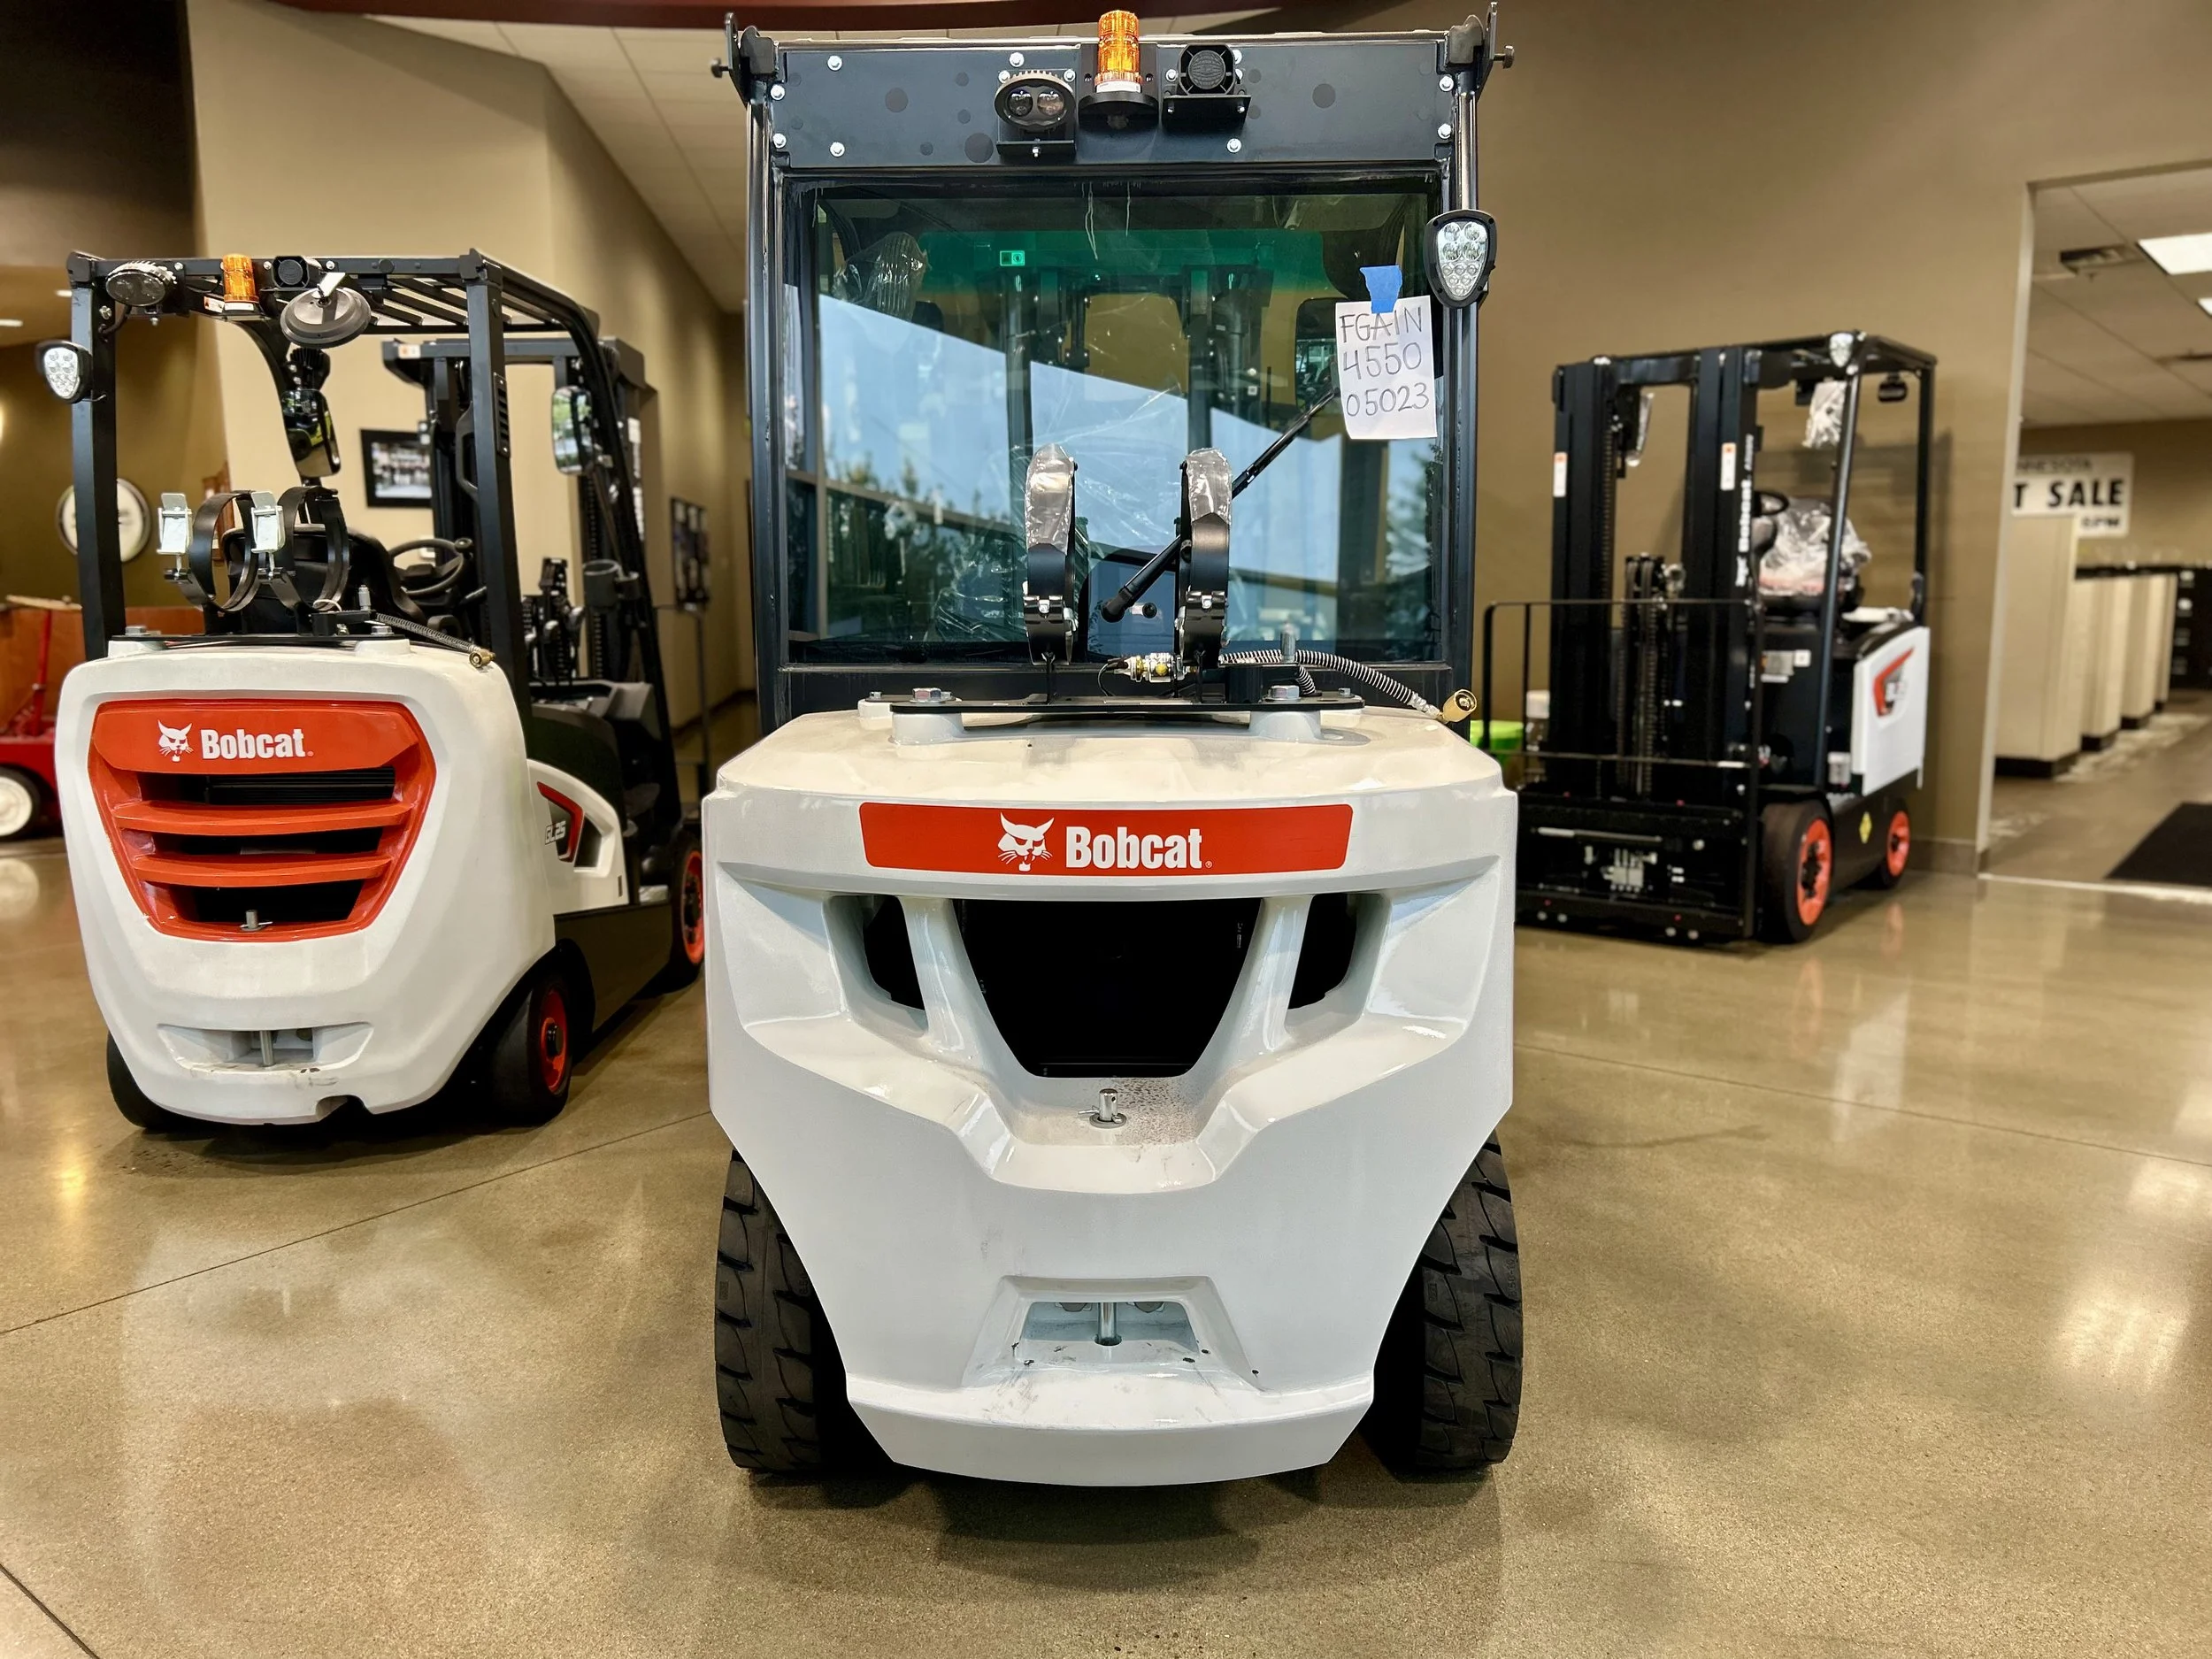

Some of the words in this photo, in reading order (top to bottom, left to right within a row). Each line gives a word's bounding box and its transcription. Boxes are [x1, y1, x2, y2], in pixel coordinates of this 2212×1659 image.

[1343, 342, 1422, 380] 4550
[1346, 382, 1430, 417] 05023
[2047, 478, 2126, 508] SALE
[200, 728, 306, 760] Bobcat
[1065, 826, 1203, 869] Bobcat
